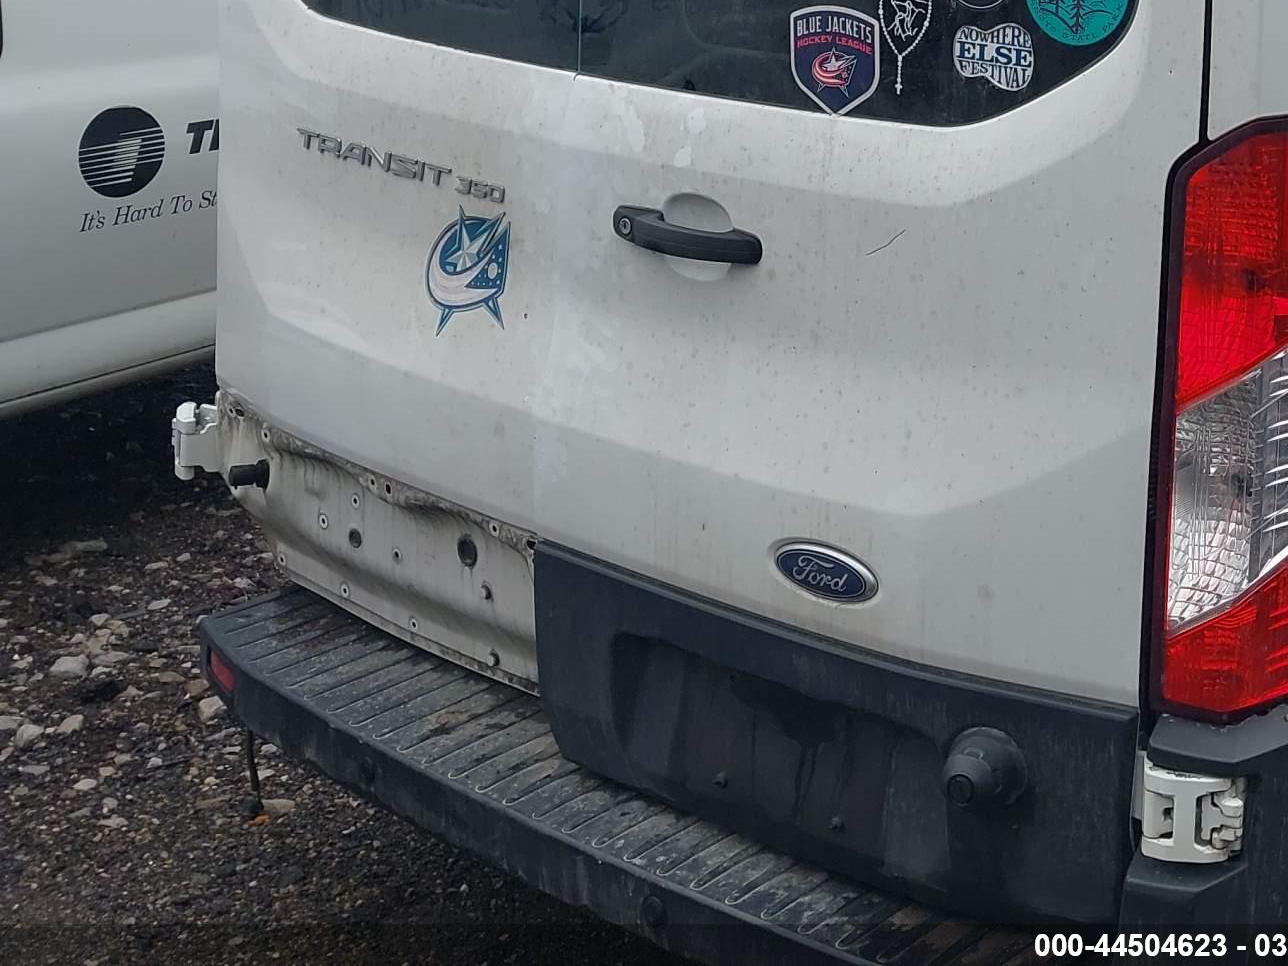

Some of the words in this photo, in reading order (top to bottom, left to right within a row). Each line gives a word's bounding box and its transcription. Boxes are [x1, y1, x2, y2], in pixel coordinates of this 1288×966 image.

[796, 15, 822, 37] BLUE
[825, 15, 872, 44] JACKETS
[957, 26, 1032, 49] NOWHERE
[797, 35, 833, 48] HOCKEY
[836, 36, 873, 55] LEAGUE
[956, 40, 1032, 68] ELSE
[958, 59, 1031, 89] FESTIVAL
[297, 127, 453, 186] TRANSIT
[454, 175, 506, 203] 350
[79, 209, 106, 233] It's
[112, 198, 164, 226] Hard
[170, 194, 193, 215] To
[199, 190, 218, 209] St
[792, 555, 849, 592] Ford
